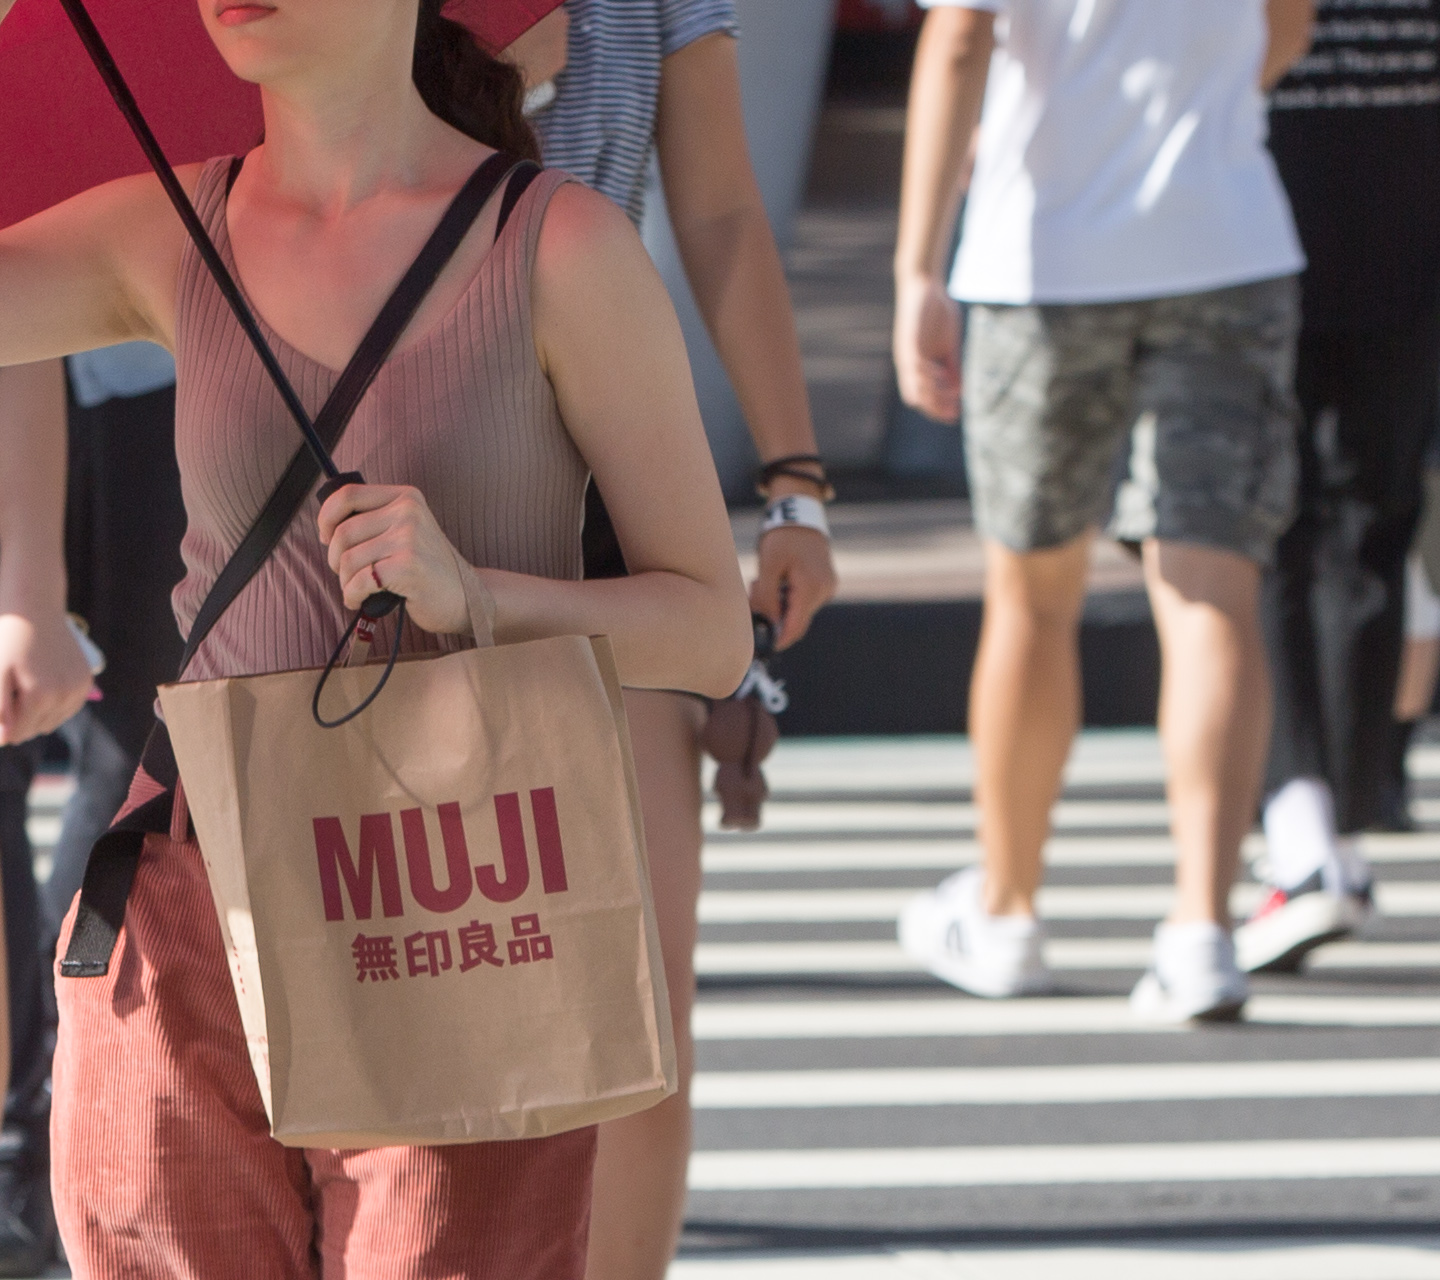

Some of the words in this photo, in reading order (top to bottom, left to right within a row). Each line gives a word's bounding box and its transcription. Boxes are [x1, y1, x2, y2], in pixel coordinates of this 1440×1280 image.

[312, 786, 568, 922] MUJI
[351, 913, 555, 983] 無印良品
